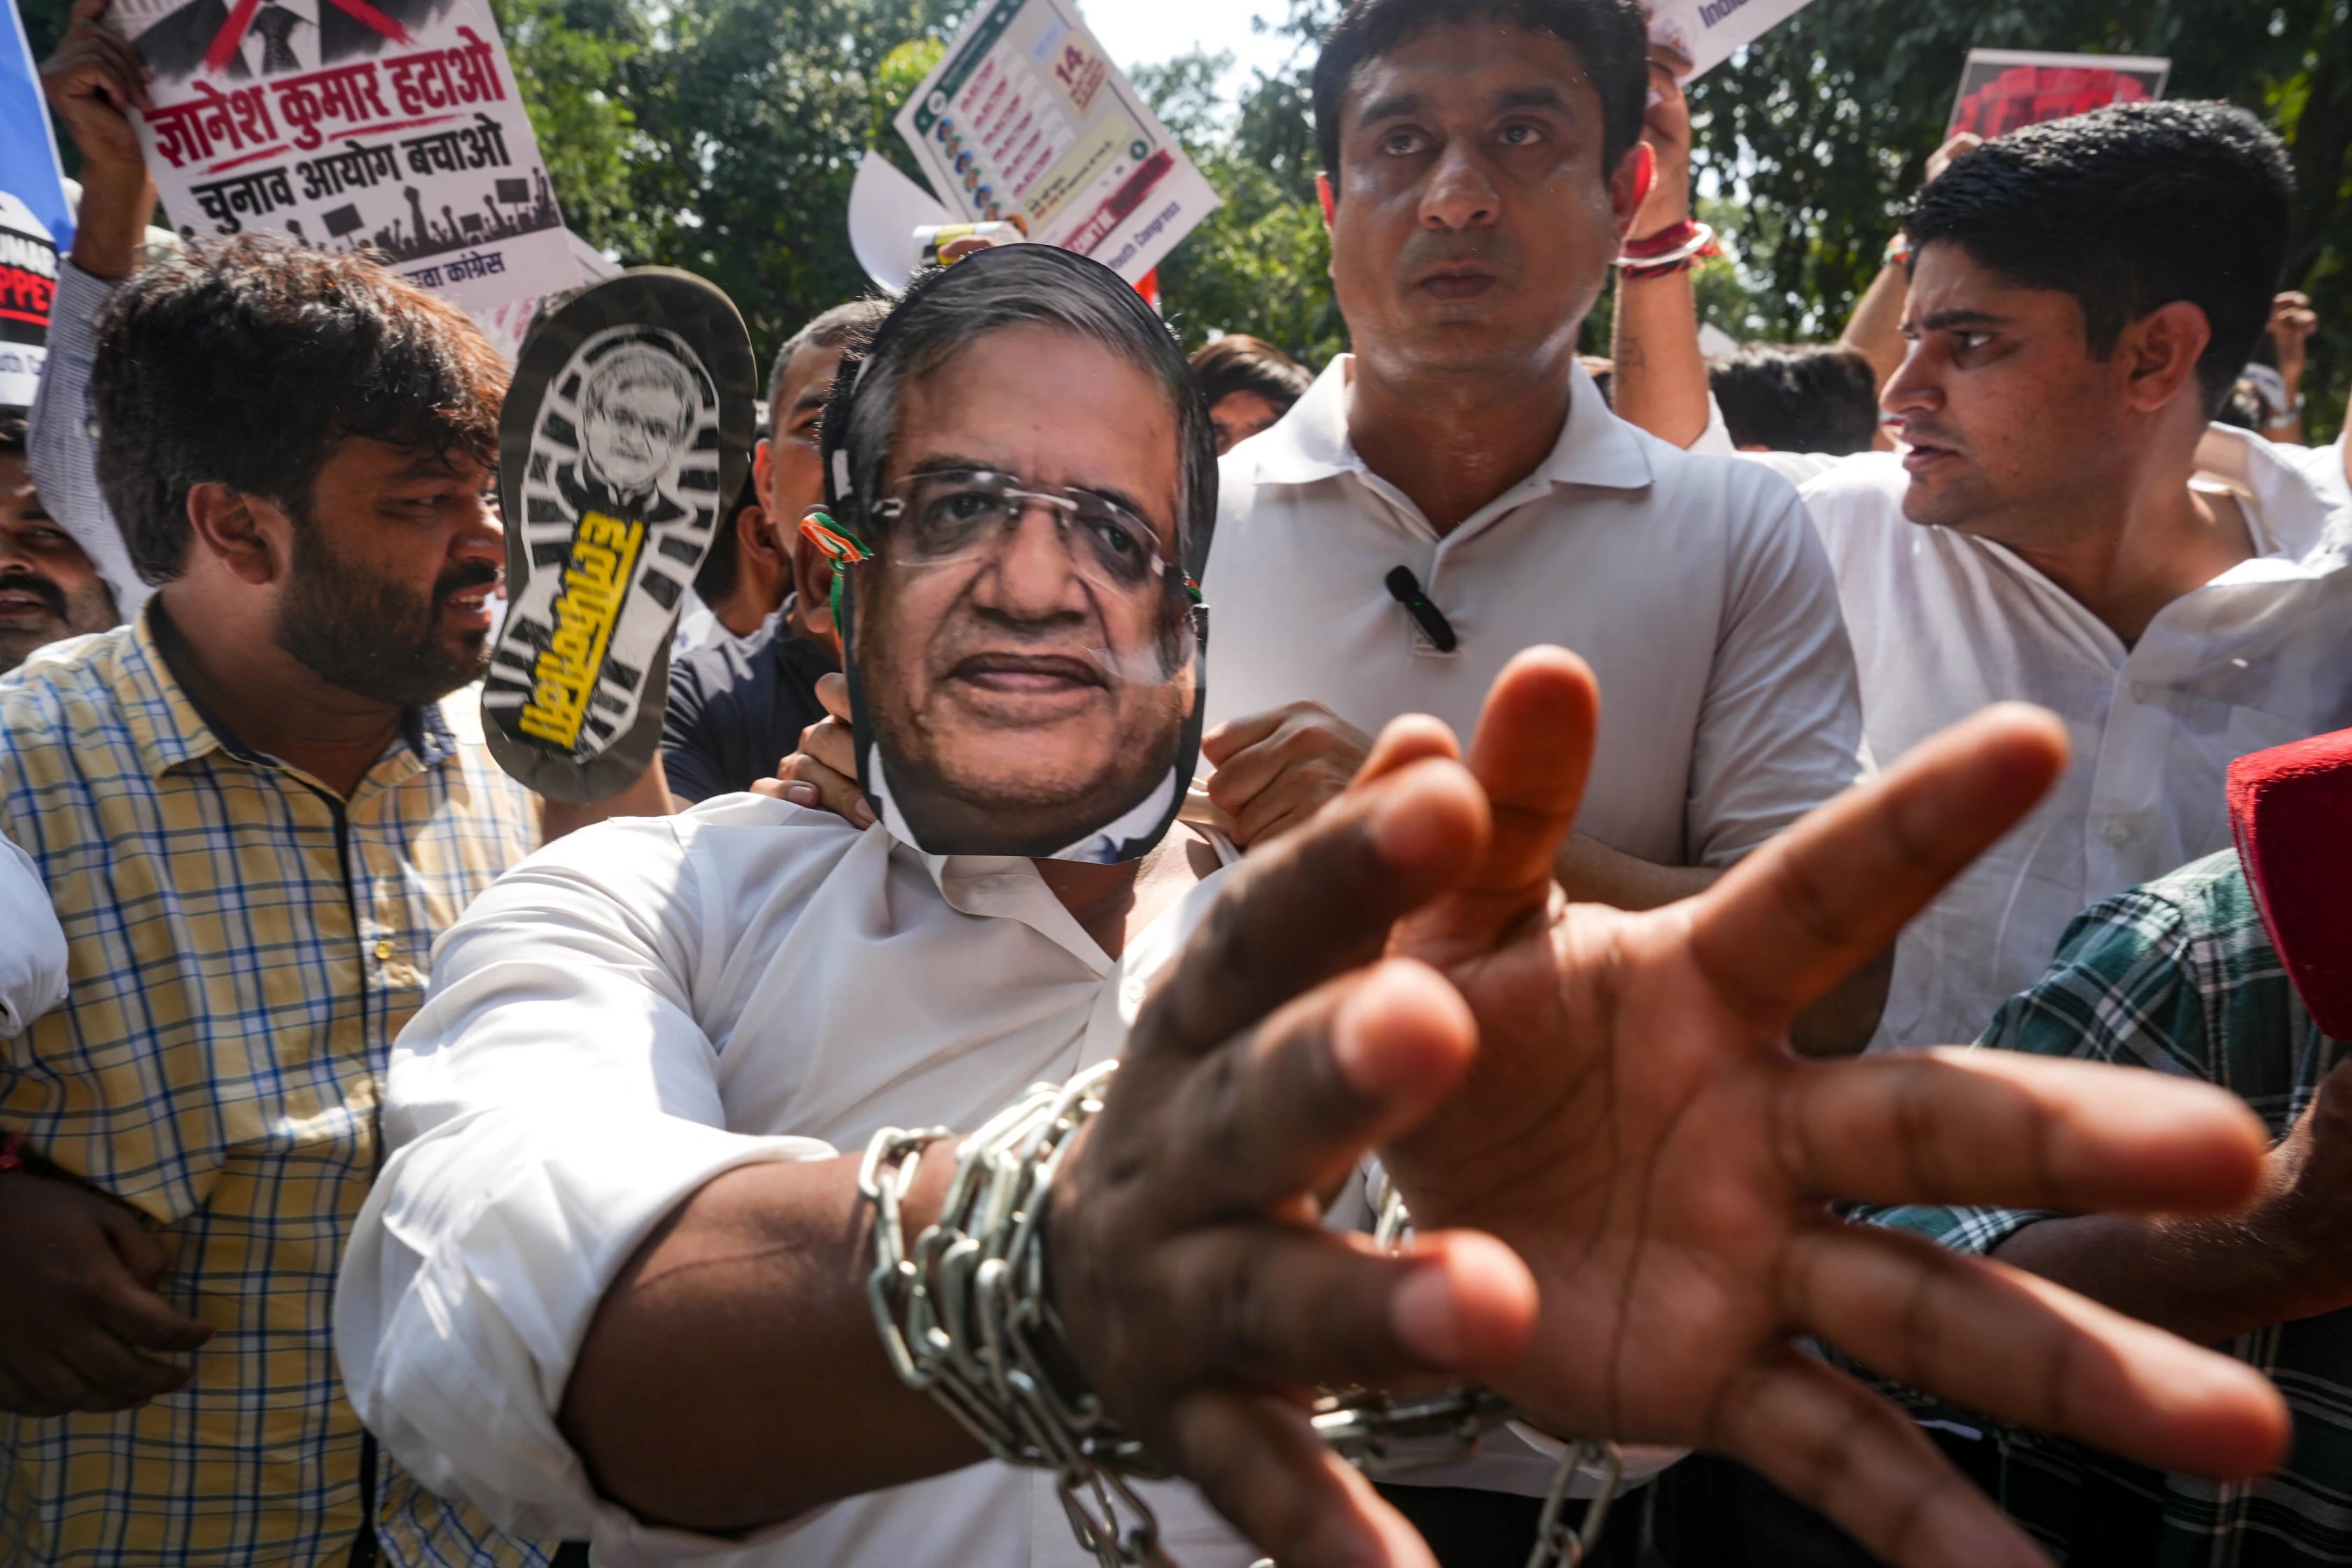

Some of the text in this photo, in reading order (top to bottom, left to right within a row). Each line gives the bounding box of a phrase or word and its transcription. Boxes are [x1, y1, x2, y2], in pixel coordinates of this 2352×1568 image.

[143, 25, 506, 168] ज्ञानेश कुमार हटाओ
[1056, 45, 1084, 84] 14
[189, 111, 512, 235] चुनाव आयोग बचाओ
[1133, 201, 1182, 246] Congress
[442, 251, 505, 282] कांग्रेस
[519, 510, 644, 750] हलफनामा
